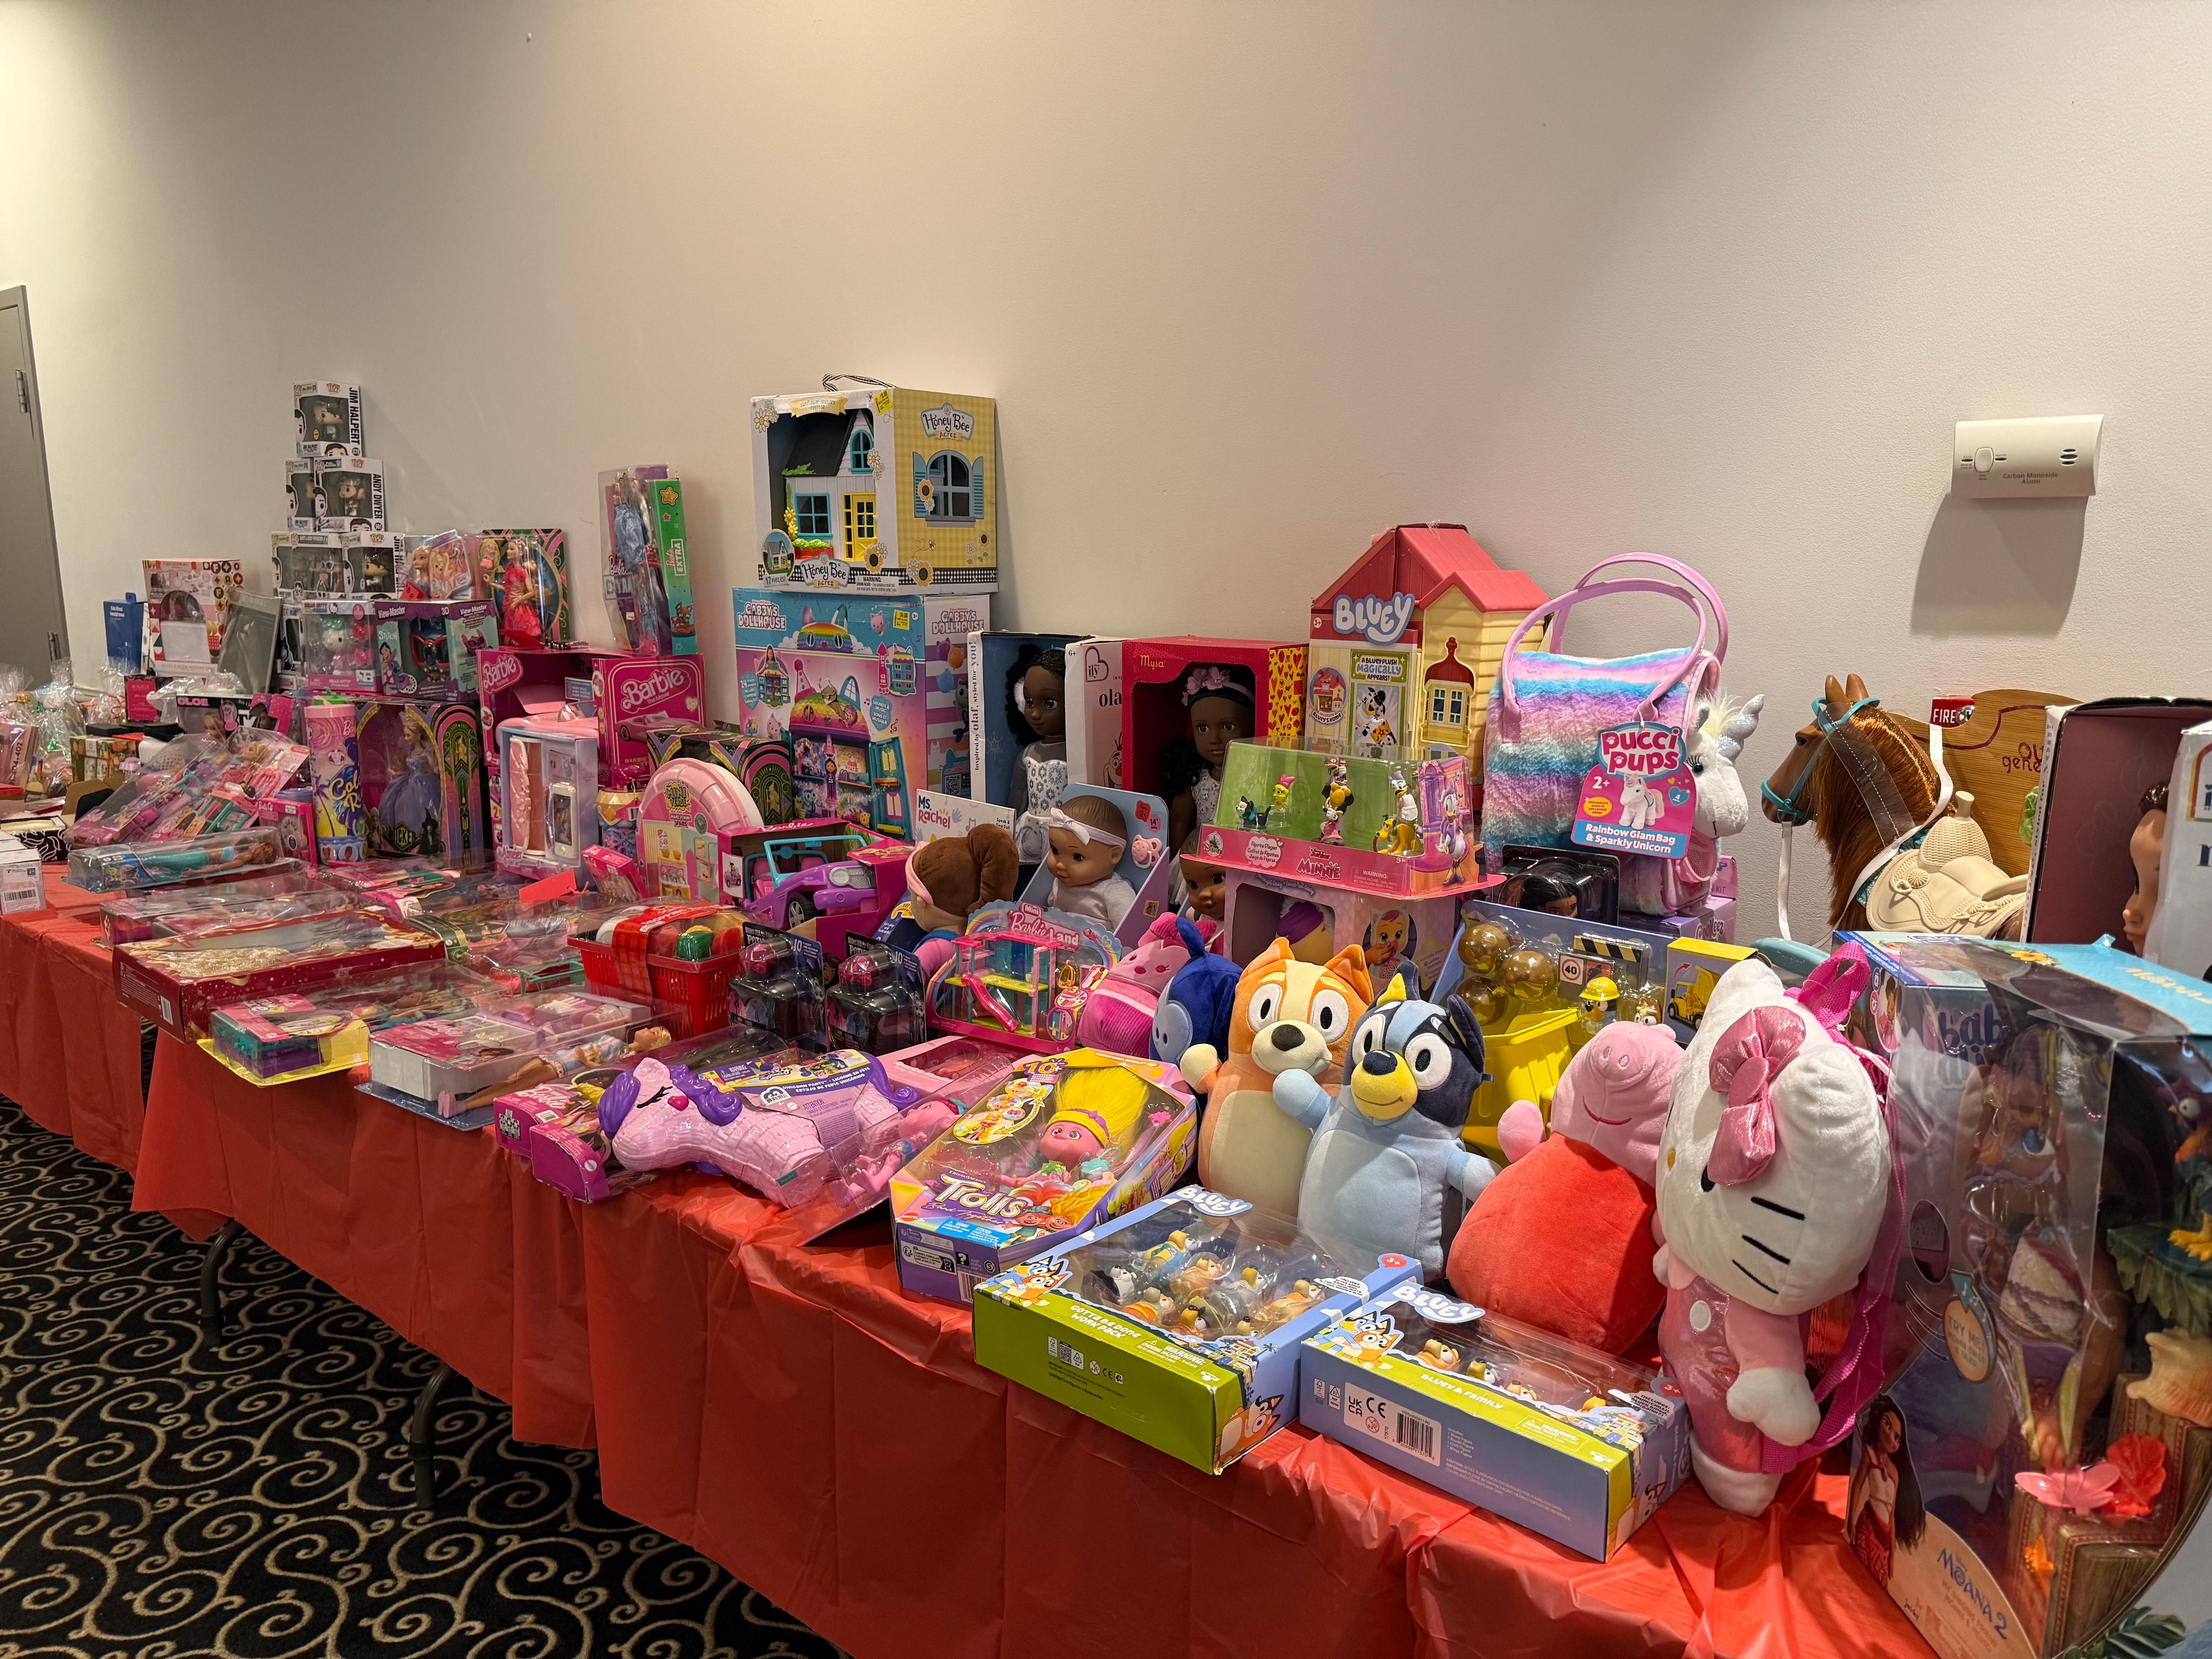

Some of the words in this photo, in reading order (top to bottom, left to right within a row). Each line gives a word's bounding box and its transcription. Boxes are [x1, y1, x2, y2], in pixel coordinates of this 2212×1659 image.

[349, 387, 359, 404] JIM
[350, 406, 360, 445] HALPERT
[922, 413, 952, 433] Honey
[953, 415, 970, 433] Bee
[373, 474, 382, 493] ANDY
[374, 494, 383, 519] DWYER
[608, 555, 627, 576] Barbie
[674, 543, 684, 573] EXTRA
[802, 563, 828, 580] Honey
[830, 562, 846, 579] Bee
[377, 606, 406, 619] View-Master
[441, 607, 450, 616] 3D
[745, 603, 778, 616] GABBY'S
[941, 610, 976, 623] GABBY'S
[737, 613, 786, 630] DOLLHOUSE
[931, 620, 984, 634] DOLLHOUSE
[1335, 596, 1412, 643] BLUEY
[969, 641, 978, 666] you!
[1141, 655, 1164, 671] Mysa
[1357, 664, 1402, 675] MAGICALLY
[483, 656, 518, 690] Barbie
[622, 668, 684, 711] Barbie
[647, 697, 656, 705] The
[657, 691, 670, 702] Movie
[1099, 688, 1122, 707] ola
[1329, 712, 1342, 722] HOME
[1933, 708, 1956, 724] FIRE
[1601, 729, 1680, 755] pucci
[1608, 751, 1680, 775] pups
[328, 770, 360, 801] Col
[1592, 776, 1610, 789] 2+
[918, 796, 932, 811] Ms.
[758, 821, 813, 832] Barbie
[918, 809, 950, 829] Rachel
[1586, 824, 1629, 838] Rainbow
[1629, 830, 1656, 842] Glam
[1657, 834, 1676, 846] Bag
[1251, 840, 1264, 849] Figurine
[1264, 842, 1278, 851] Playset
[1594, 835, 1633, 849] Sparkly
[1634, 840, 1671, 854] Unicorn
[1265, 850, 1279, 858] Figurines
[1296, 858, 1342, 880] MINNIE
[1363, 870, 1388, 879] WARNING:
[1024, 904, 1039, 915] Mini
[1011, 911, 1048, 937] Barbie
[1049, 929, 1079, 945] Land
[793, 938, 802, 952] 10
[895, 950, 903, 965] 10
[1565, 965, 1577, 975] 40
[1938, 1003, 2008, 1054] bab
[832, 1072, 851, 1082] LICORNE
[782, 1083, 807, 1091] UNICORN
[796, 1084, 817, 1093] ESTOJO
[825, 1081, 839, 1089] FESTA
[935, 1173, 1027, 1217] Trolls
[1176, 1187, 1248, 1214] BLUEY
[1385, 1256, 1402, 1266] 3+
[1392, 1286, 1482, 1321] BLUEY
[1070, 1305, 1101, 1321] GOTTA
[1102, 1317, 1113, 1326] BE
[1113, 1321, 1142, 1338] DONE
[1070, 1313, 1099, 1328] WORK
[1099, 1325, 1126, 1339] PACK
[1164, 1345, 1207, 1365] WARNING:
[1455, 1386, 1463, 1394] &
[1664, 1384, 1680, 1393] 3+
[1349, 1396, 1363, 1409] UK
[1349, 1405, 1363, 1417] CA
[1542, 1423, 1578, 1442] WARNING:
[1994, 1612, 2008, 1640] 2
